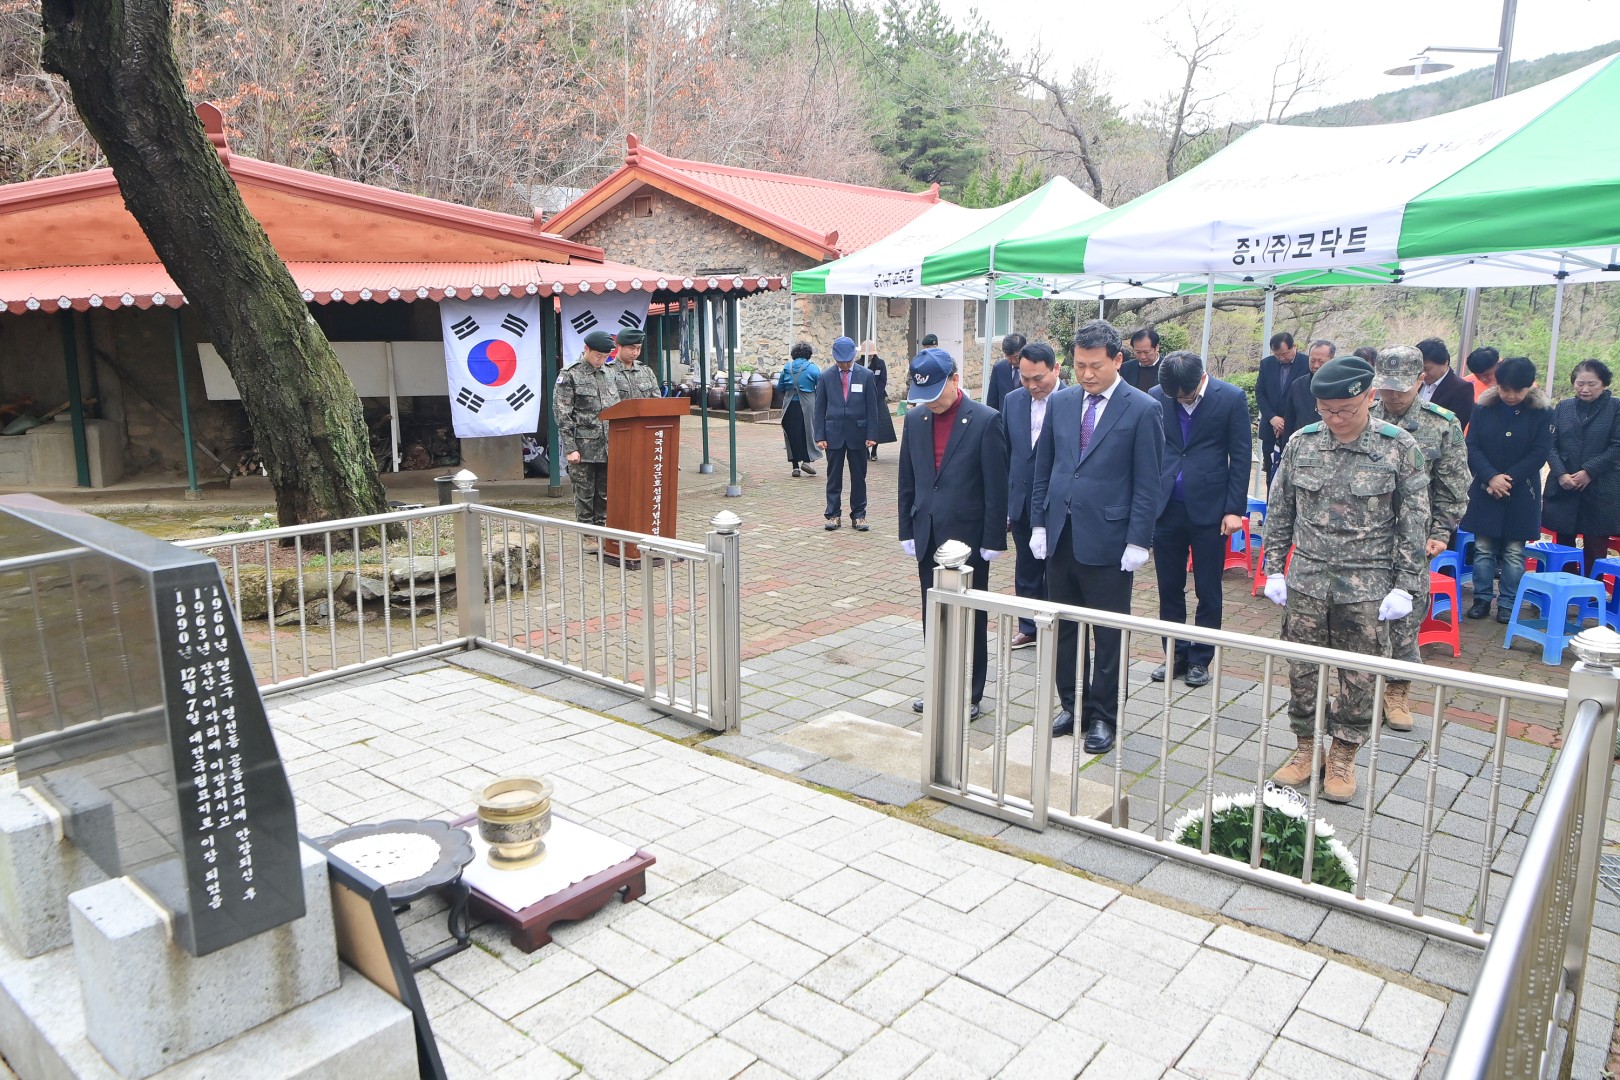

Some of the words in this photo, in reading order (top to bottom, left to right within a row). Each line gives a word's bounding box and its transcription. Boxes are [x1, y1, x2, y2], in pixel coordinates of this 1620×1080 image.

[651, 429, 664, 537] 애국지사강근호선생기념사업
[174, 588, 192, 660] 1990년
[194, 587, 210, 656] 1963년
[211, 585, 228, 653] 1960년
[180, 666, 197, 695] 12월
[185, 698, 200, 725] 7일
[216, 657, 235, 699] 영도구
[221, 705, 240, 749] 영선동
[227, 753, 247, 821] 공동묘지에
